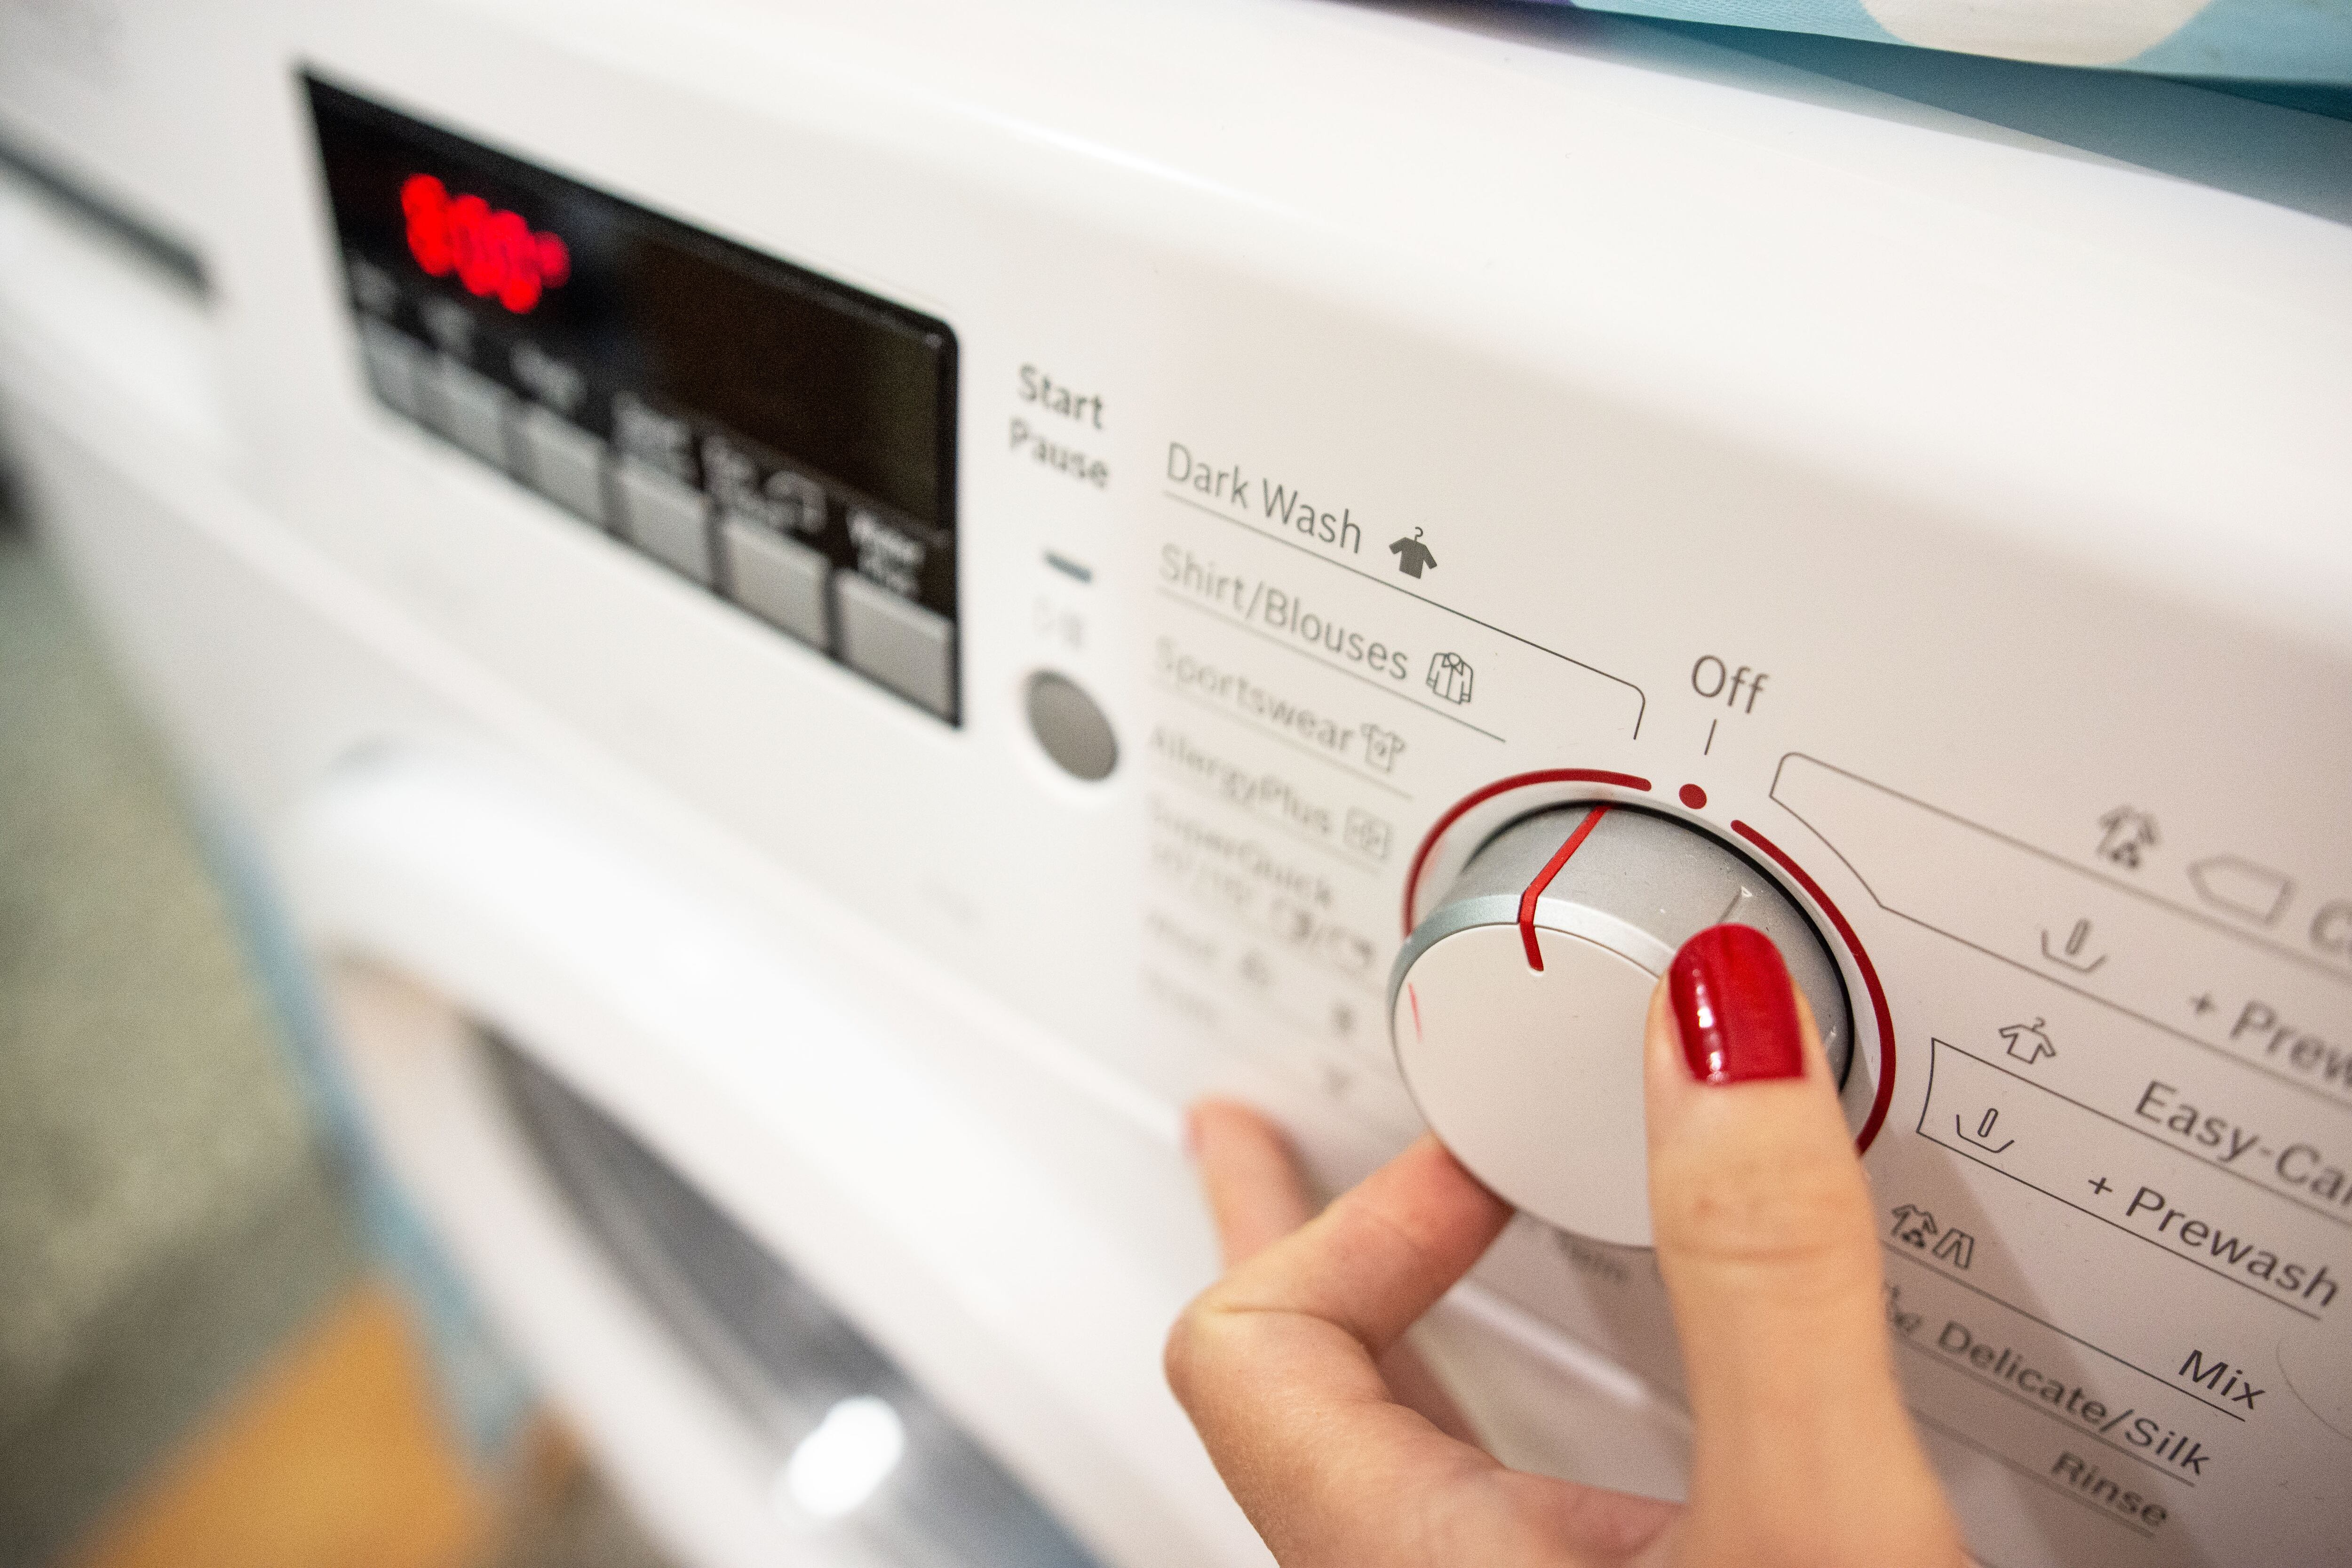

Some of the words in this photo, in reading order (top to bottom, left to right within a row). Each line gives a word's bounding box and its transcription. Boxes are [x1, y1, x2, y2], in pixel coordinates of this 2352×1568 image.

[1018, 364, 1104, 429] Start
[1010, 417, 1109, 487] Pause
[1167, 442, 1248, 508] Dark
[1263, 477, 1361, 553] Wash
[1160, 543, 1407, 680] Shirt/Blouses
[1155, 635, 1356, 754] Sportswear
[1691, 655, 1769, 714] Off
[2126, 1186, 2339, 1307] Prewash
[1938, 1322, 2210, 1475] Delicate/Silk
[2178, 1350, 2265, 1409] Mix
[2052, 1452, 2167, 1527] Rinse
